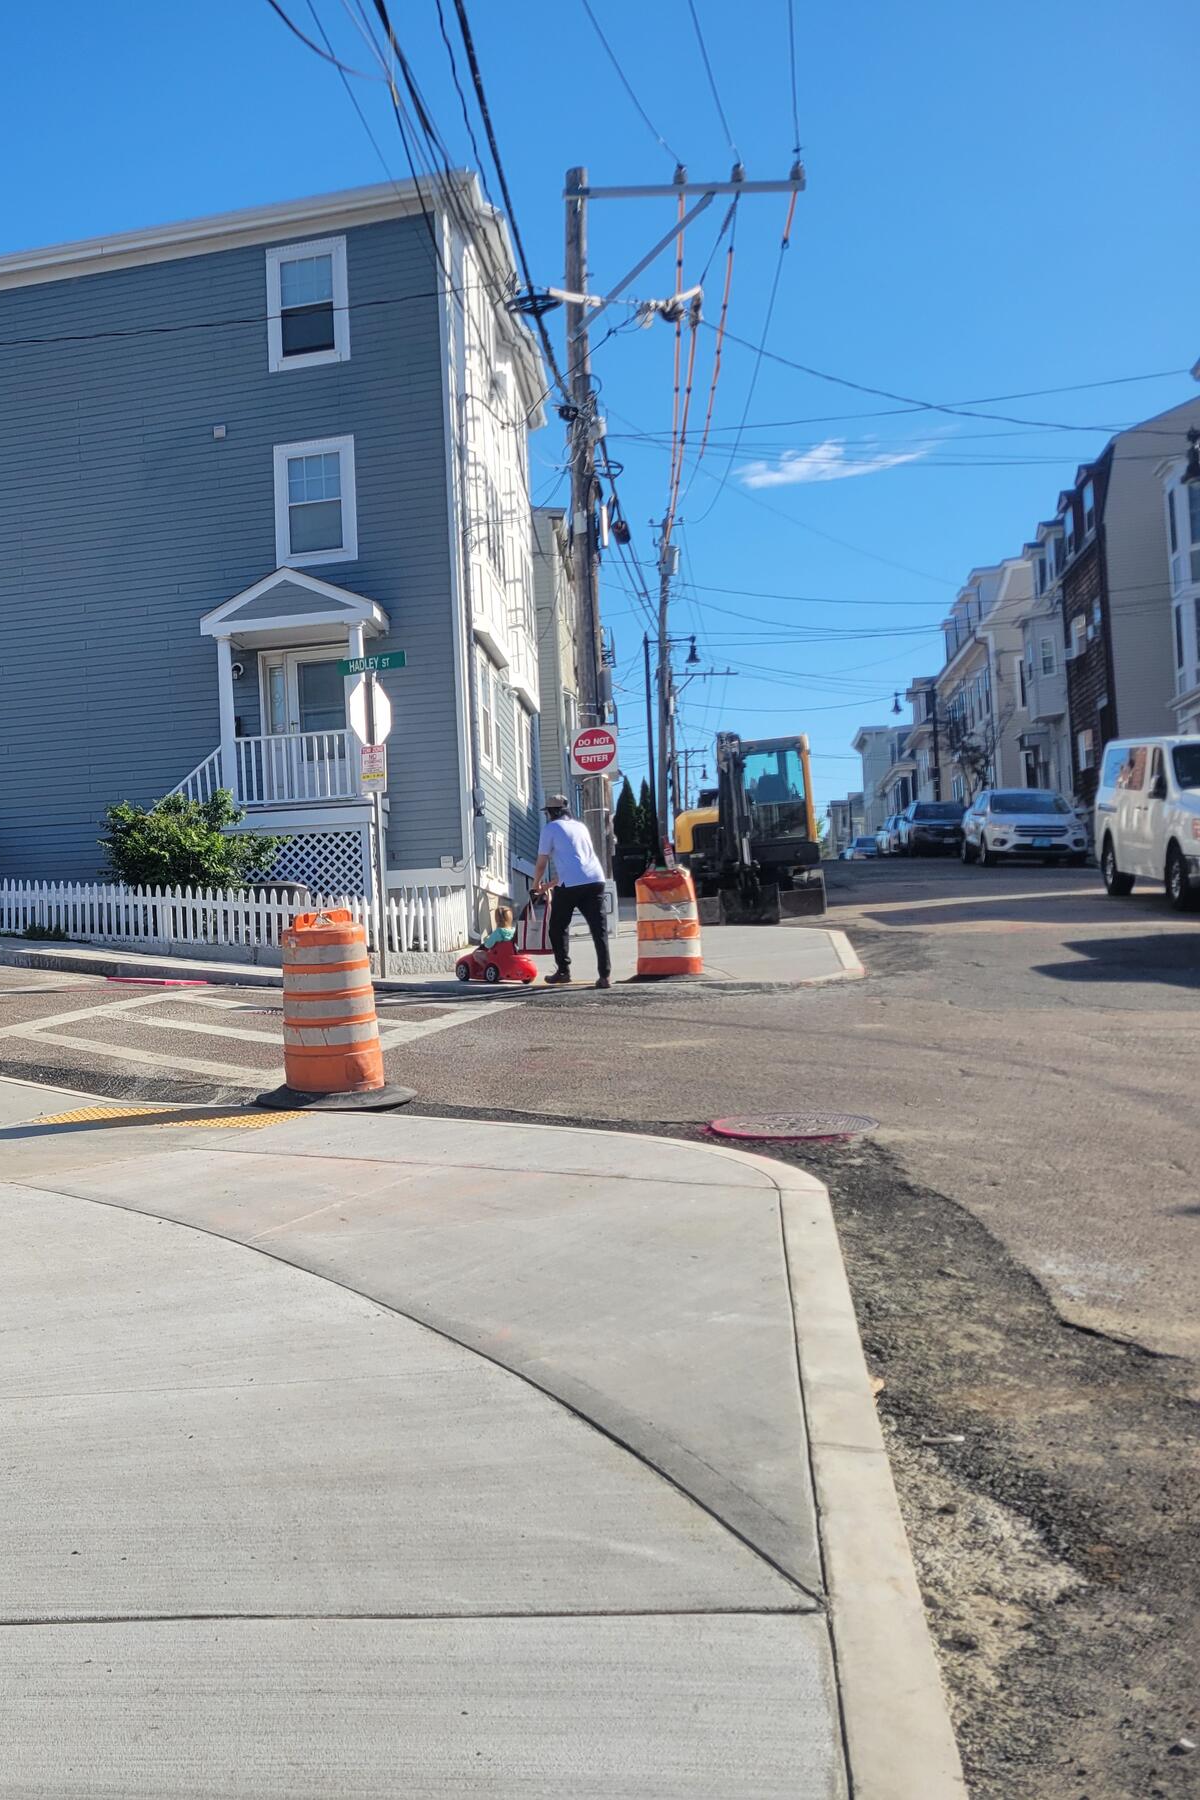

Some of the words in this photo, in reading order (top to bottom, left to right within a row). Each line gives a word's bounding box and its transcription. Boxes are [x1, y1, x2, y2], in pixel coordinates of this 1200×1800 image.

[349, 656, 379, 672] HADLEY
[381, 657, 390, 668] ST
[593, 737, 610, 745] NOT
[581, 754, 608, 763] ENTER
